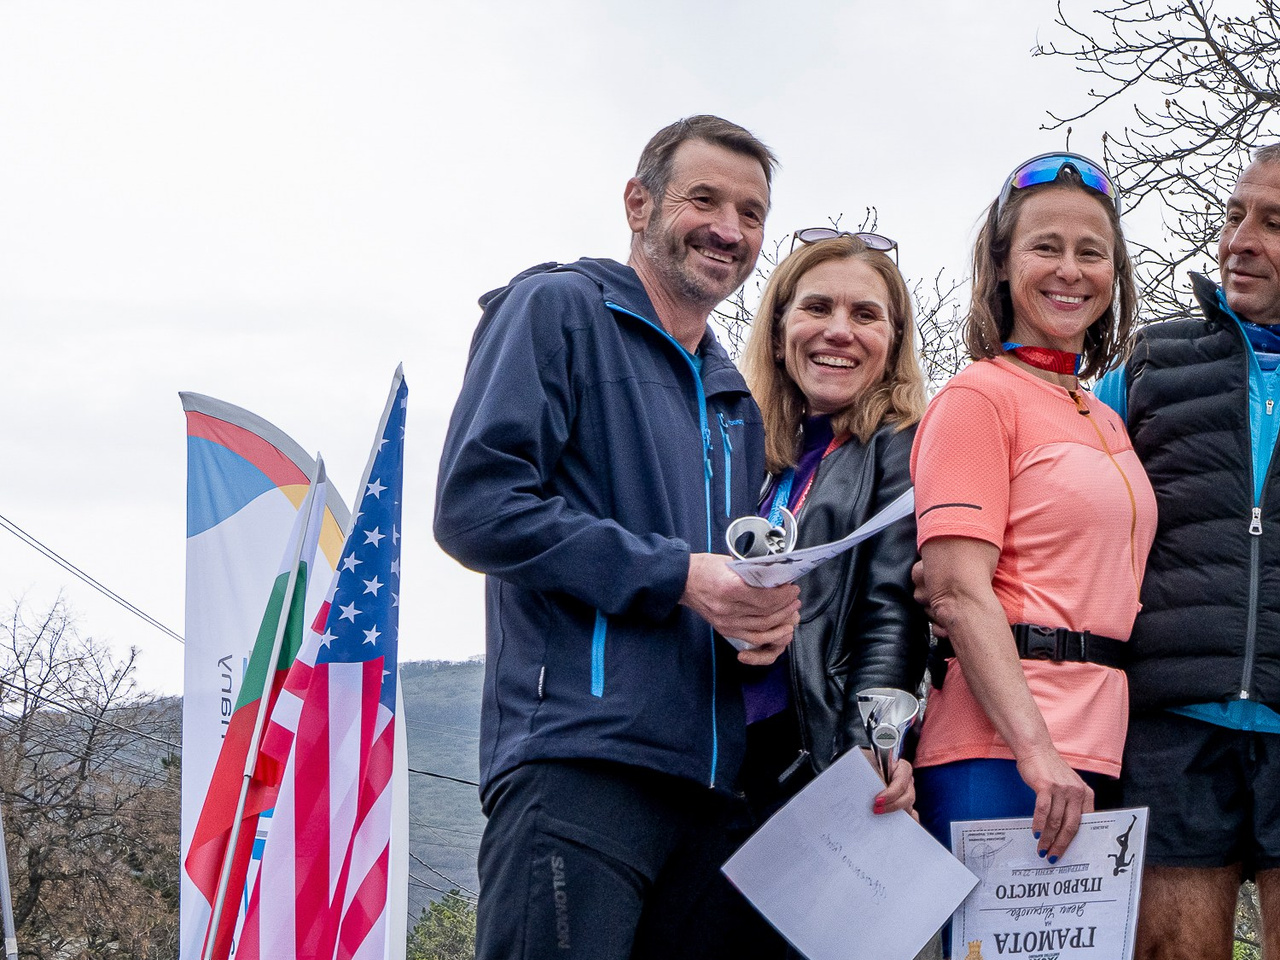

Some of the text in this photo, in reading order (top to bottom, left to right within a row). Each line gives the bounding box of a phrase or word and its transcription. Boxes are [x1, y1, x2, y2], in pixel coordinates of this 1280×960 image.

[1058, 863, 1089, 873] ВЕТЕРАНИ
[995, 877, 1102, 899] ПЪРВО МЯСТО
[551, 856, 570, 948] SALOMON
[994, 927, 1097, 954] ГРАМОТА
